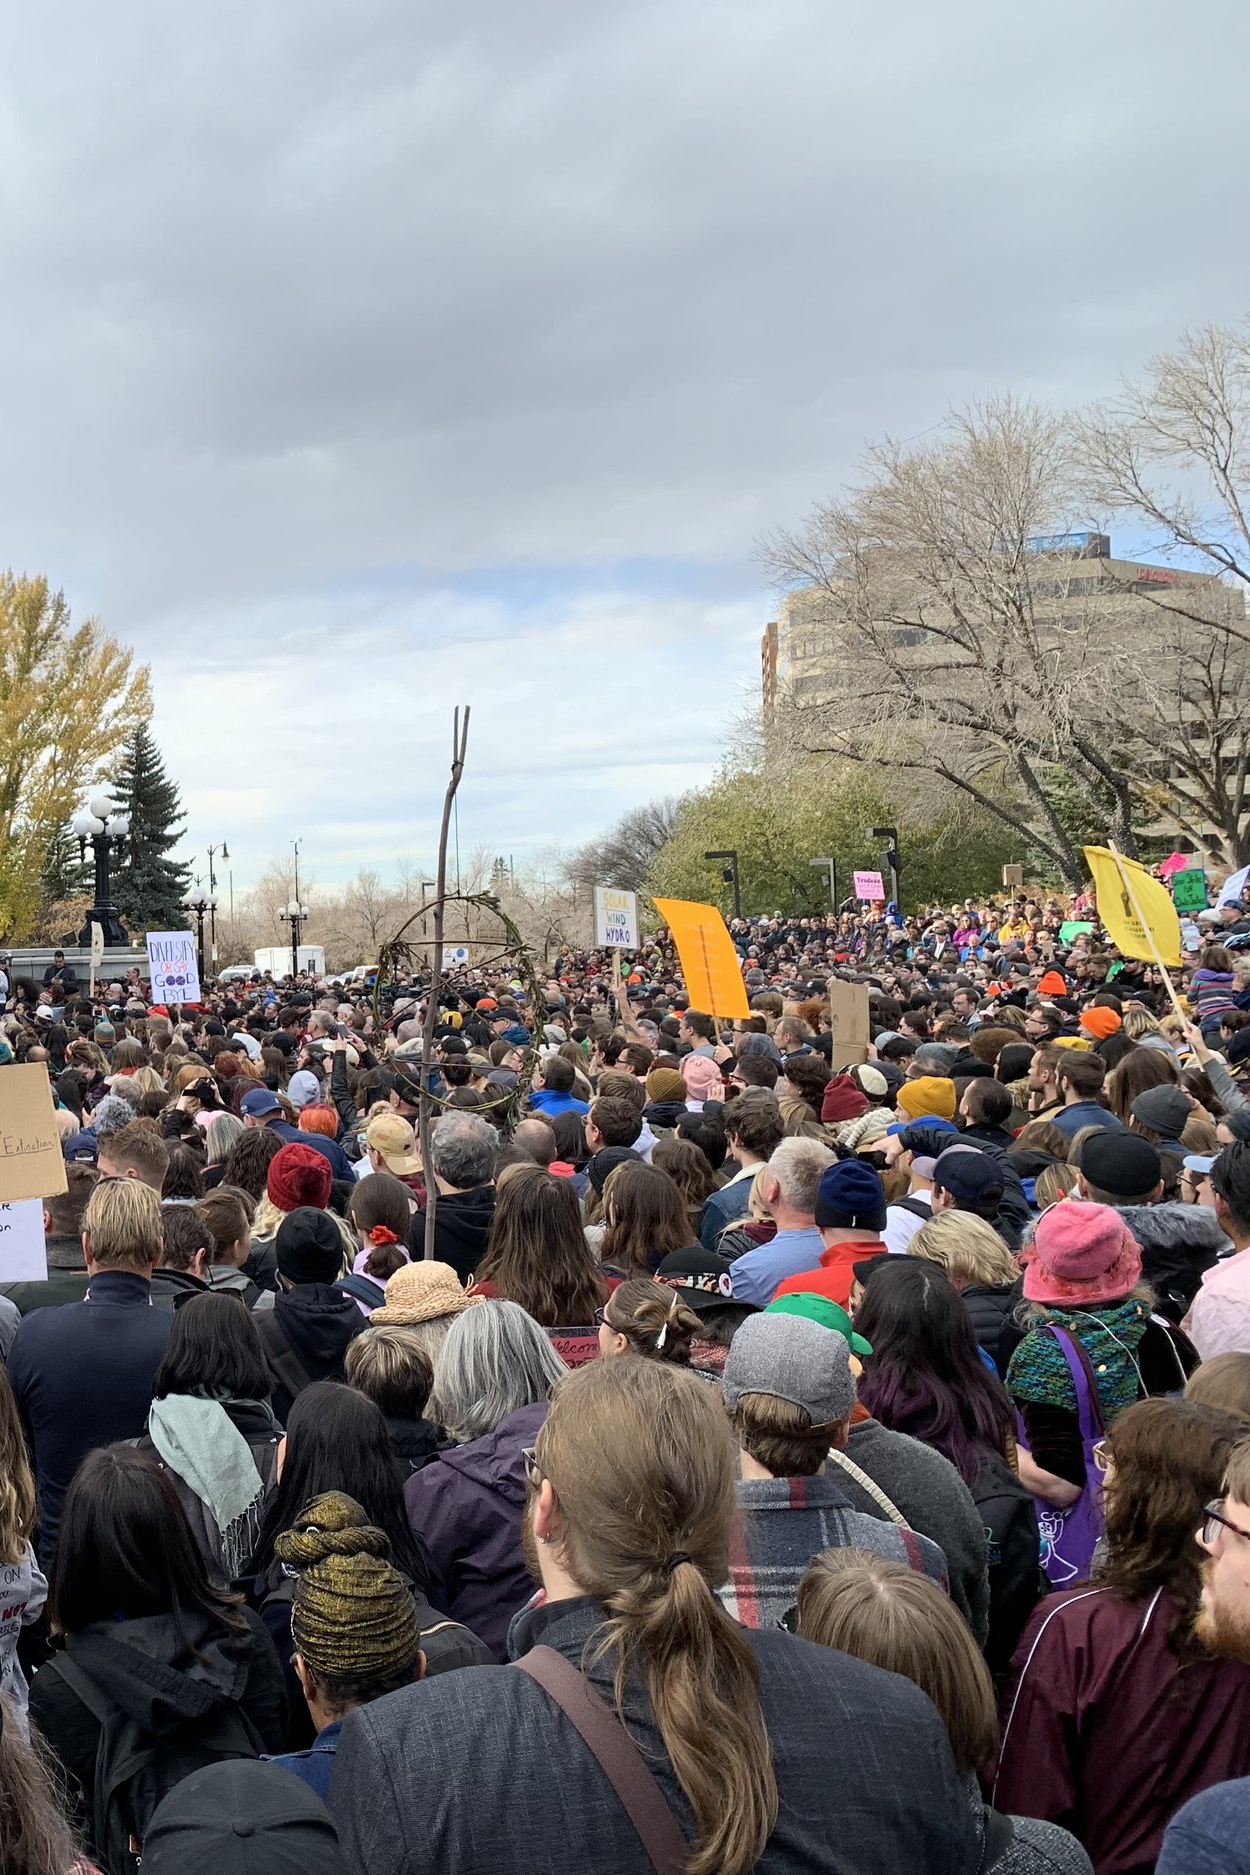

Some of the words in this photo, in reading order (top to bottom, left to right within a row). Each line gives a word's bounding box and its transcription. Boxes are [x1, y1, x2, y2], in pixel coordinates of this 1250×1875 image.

[603, 892, 630, 910] SOLAR
[607, 911, 626, 926] WIND
[606, 926, 631, 943] HYDRO
[150, 940, 195, 962] DIVERSIFY
[160, 961, 172, 973] OR
[174, 960, 188, 973] SAY
[154, 972, 196, 988] GOOD
[163, 987, 193, 1002] BYE
[4, 1567, 21, 1585] ON
[1, 1601, 28, 1622] NOT
